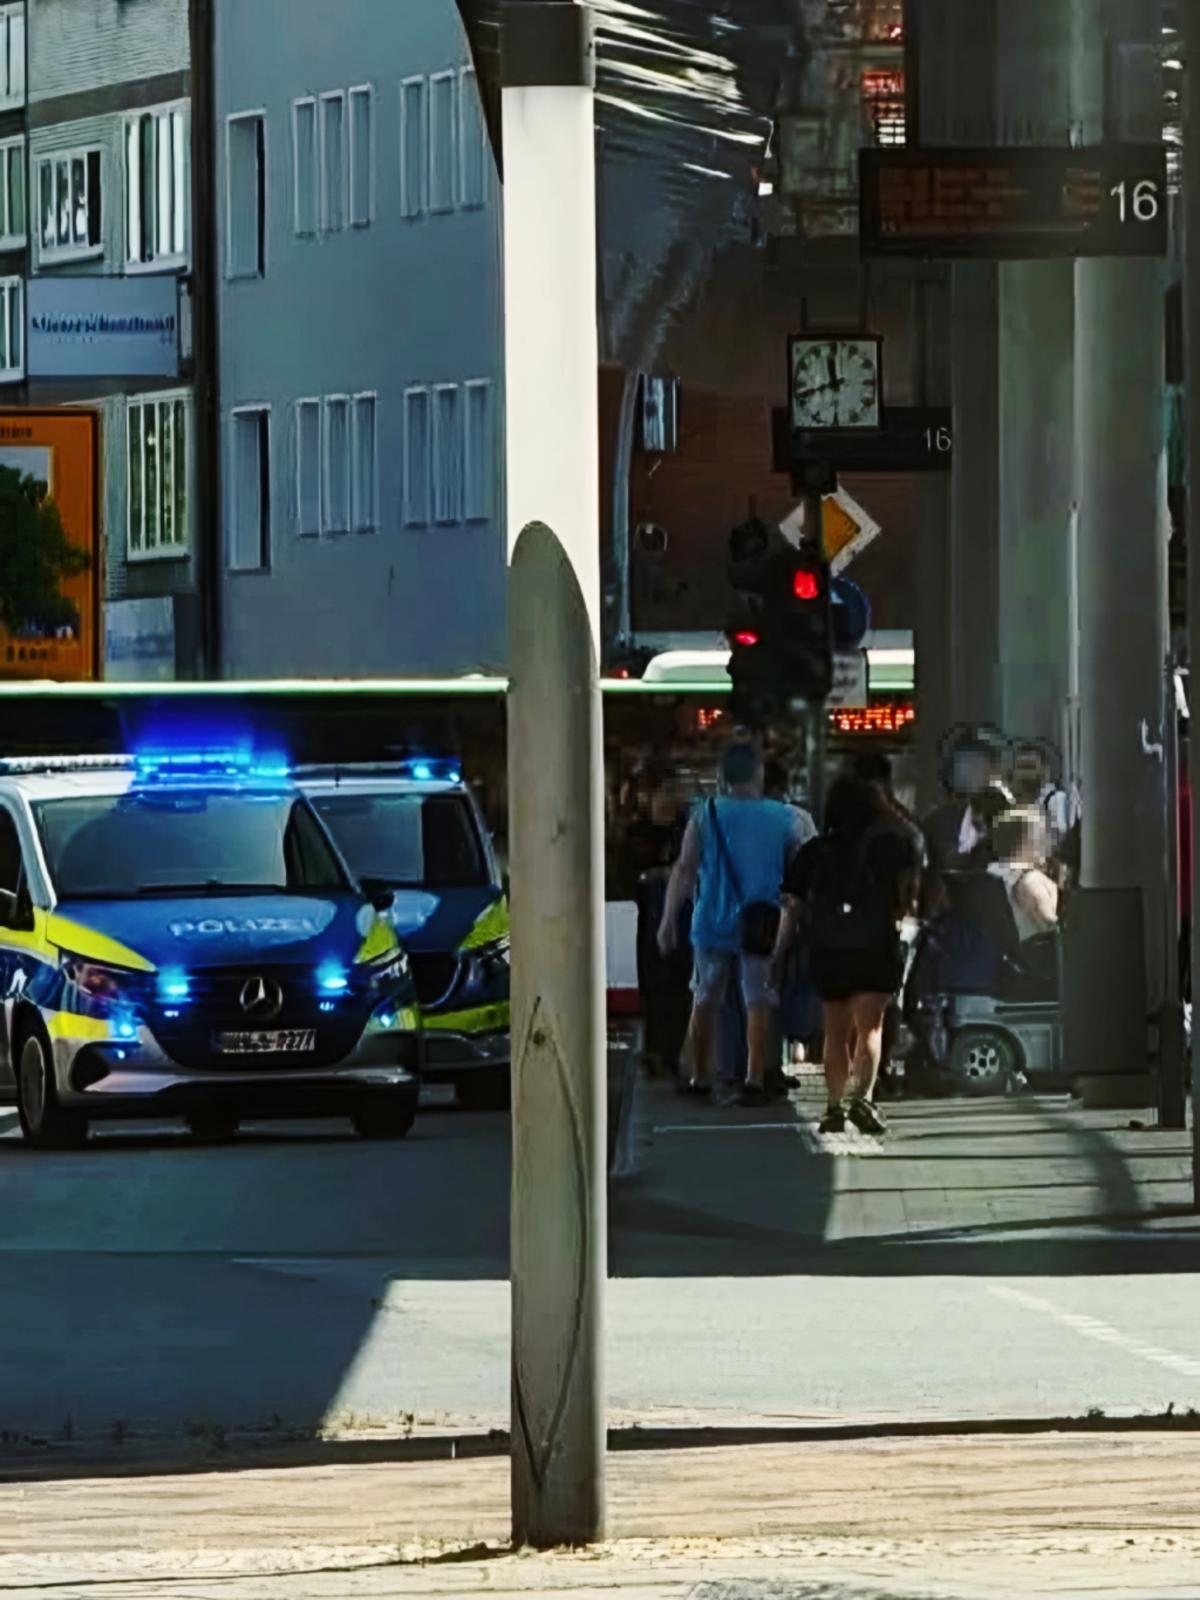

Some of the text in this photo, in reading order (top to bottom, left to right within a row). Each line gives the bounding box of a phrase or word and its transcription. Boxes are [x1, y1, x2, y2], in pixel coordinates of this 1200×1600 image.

[1110, 180, 1159, 222] 16
[924, 426, 952, 451] 16
[170, 918, 314, 937] POLIZEI
